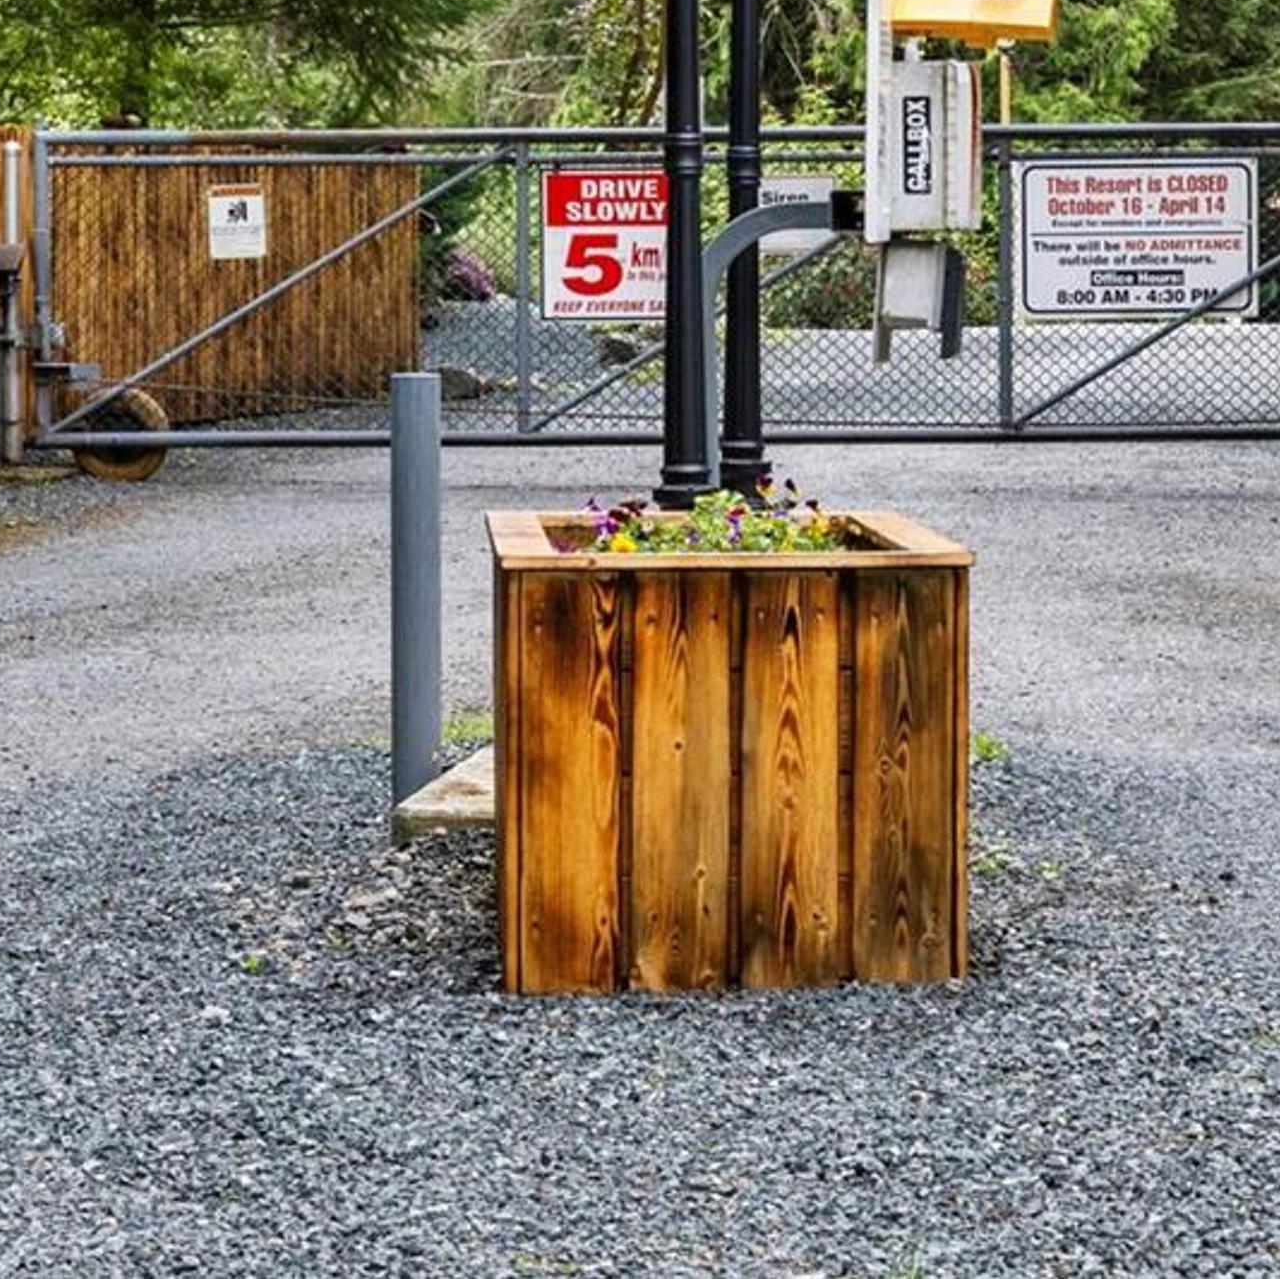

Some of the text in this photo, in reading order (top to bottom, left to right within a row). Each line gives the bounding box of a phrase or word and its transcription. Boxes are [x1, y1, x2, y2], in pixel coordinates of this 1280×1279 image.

[580, 179, 659, 200] DRIVE
[1046, 174, 1229, 195] This Resort is CLOSED
[565, 201, 668, 221] SLOWLY
[1047, 197, 1115, 216] October
[1122, 197, 1141, 216] 16
[1158, 197, 1198, 218] April
[1204, 196, 1226, 215] 14
[1033, 238, 1242, 253] There will be NO ADMITTANCE
[561, 232, 624, 297] 5
[1058, 254, 1217, 267] outside of office hours.
[1092, 272, 1134, 286] Office
[1056, 290, 1095, 305] 8:00
[1101, 289, 1130, 304] AM
[1146, 289, 1187, 304] 4:30
[1191, 288, 1219, 303] PM
[553, 299, 666, 314] KEEP EVERYONE SA
